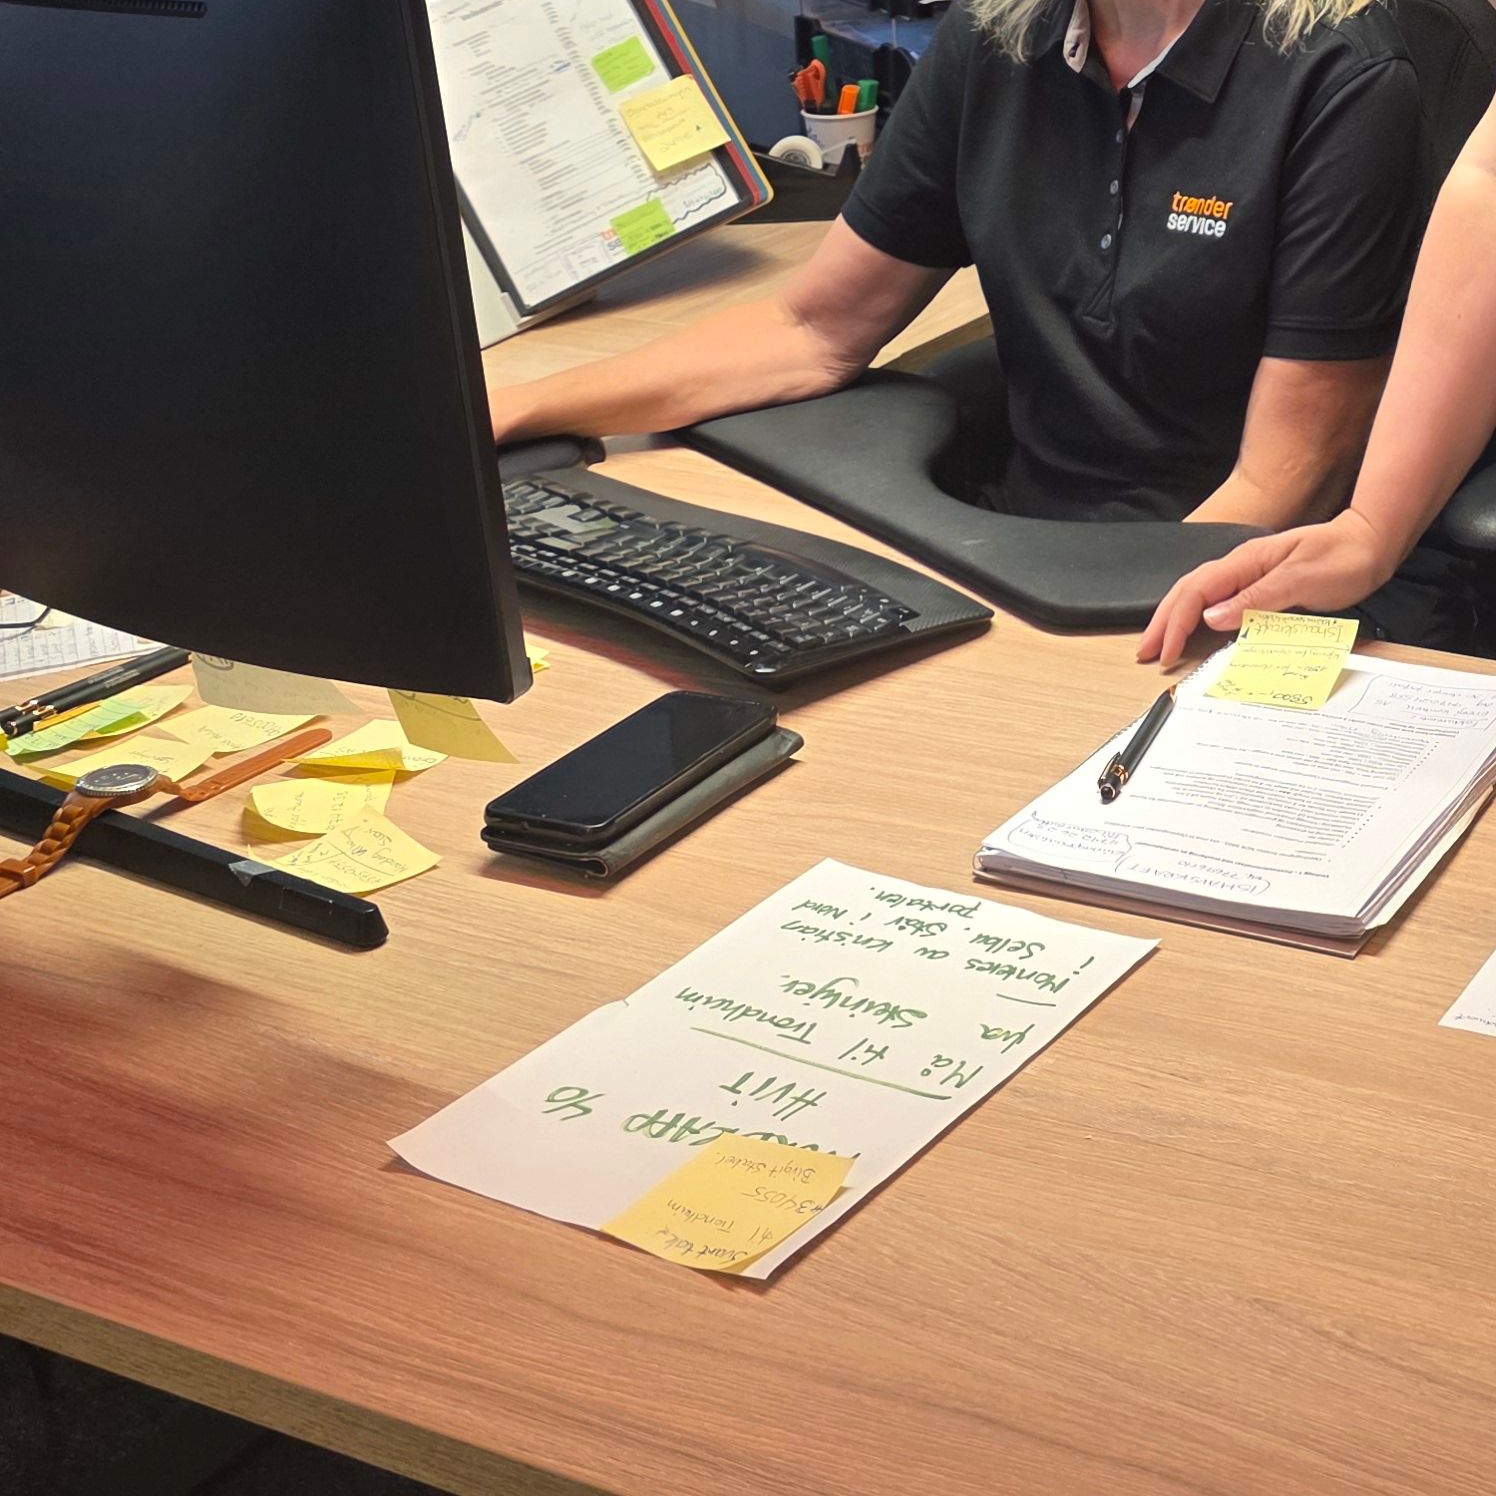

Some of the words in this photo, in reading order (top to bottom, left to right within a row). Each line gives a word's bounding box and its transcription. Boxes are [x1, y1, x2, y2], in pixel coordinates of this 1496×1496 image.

[1172, 191, 1233, 219] trønder
[1166, 212, 1226, 238] service
[866, 885, 982, 921] portalen.
[780, 919, 894, 953] Kristian
[892, 913, 948, 939] Står
[964, 957, 1070, 994] Monteres
[676, 986, 818, 1045] Trondheim
[836, 1038, 890, 1066] til
[979, 1022, 1035, 1055] fra
[920, 1054, 984, 1090] Må
[768, 1159, 817, 1184] Birgit
[664, 1199, 736, 1233] Trondheim
